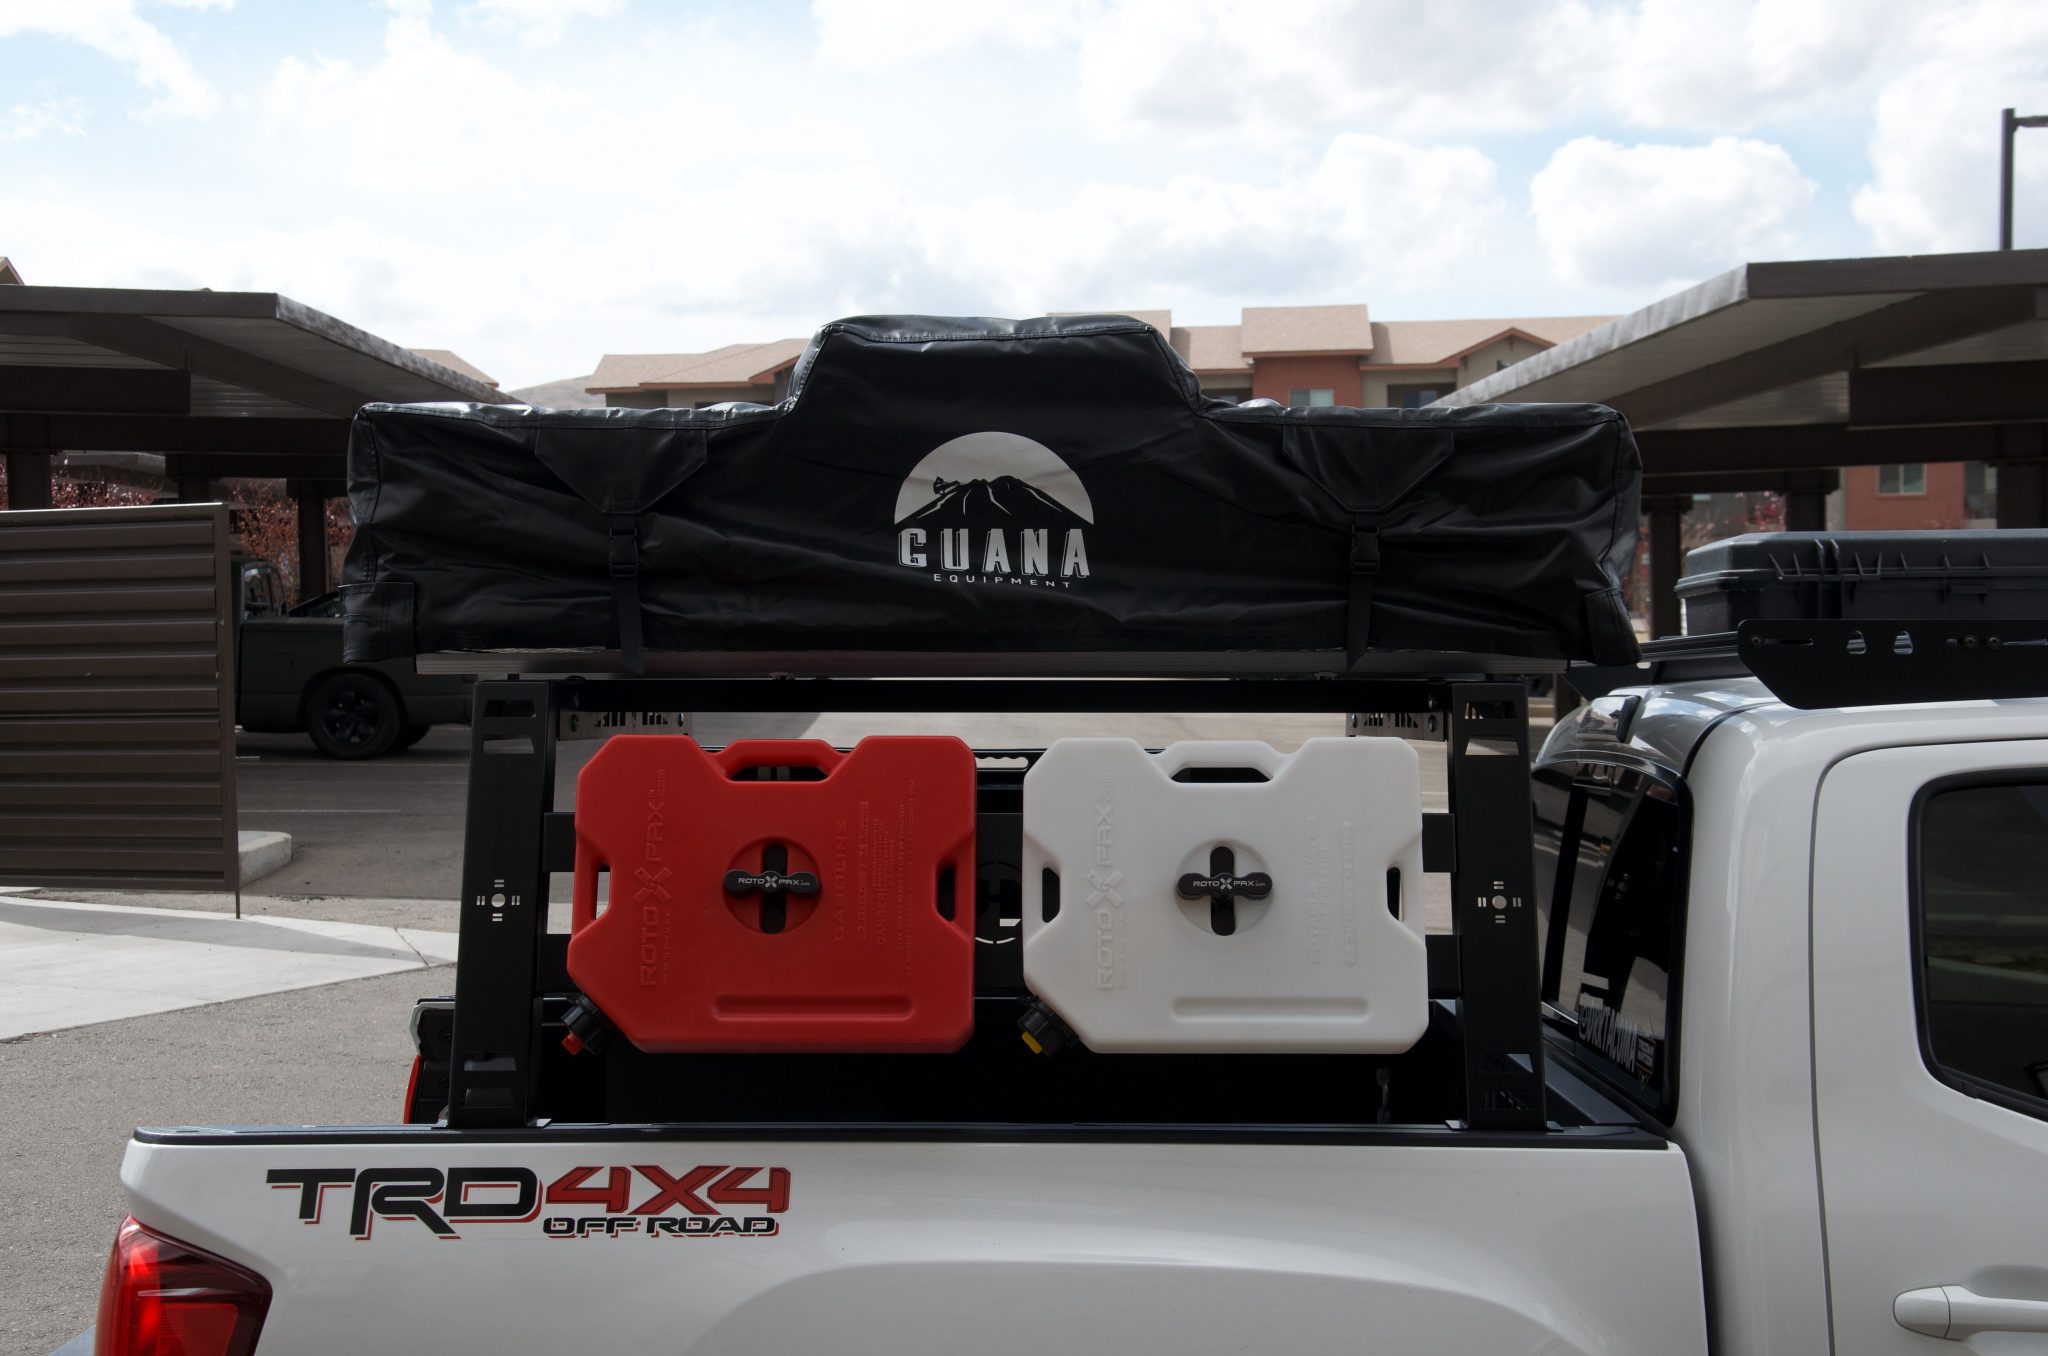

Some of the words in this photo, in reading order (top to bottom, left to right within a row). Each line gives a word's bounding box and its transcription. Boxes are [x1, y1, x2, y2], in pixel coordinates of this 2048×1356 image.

[898, 527, 1090, 578] GUANA
[934, 573, 1070, 588] EQUIPMENT
[266, 1166, 543, 1241] TRD
[542, 1216, 640, 1239] OFF
[646, 1216, 780, 1239] ROAD
